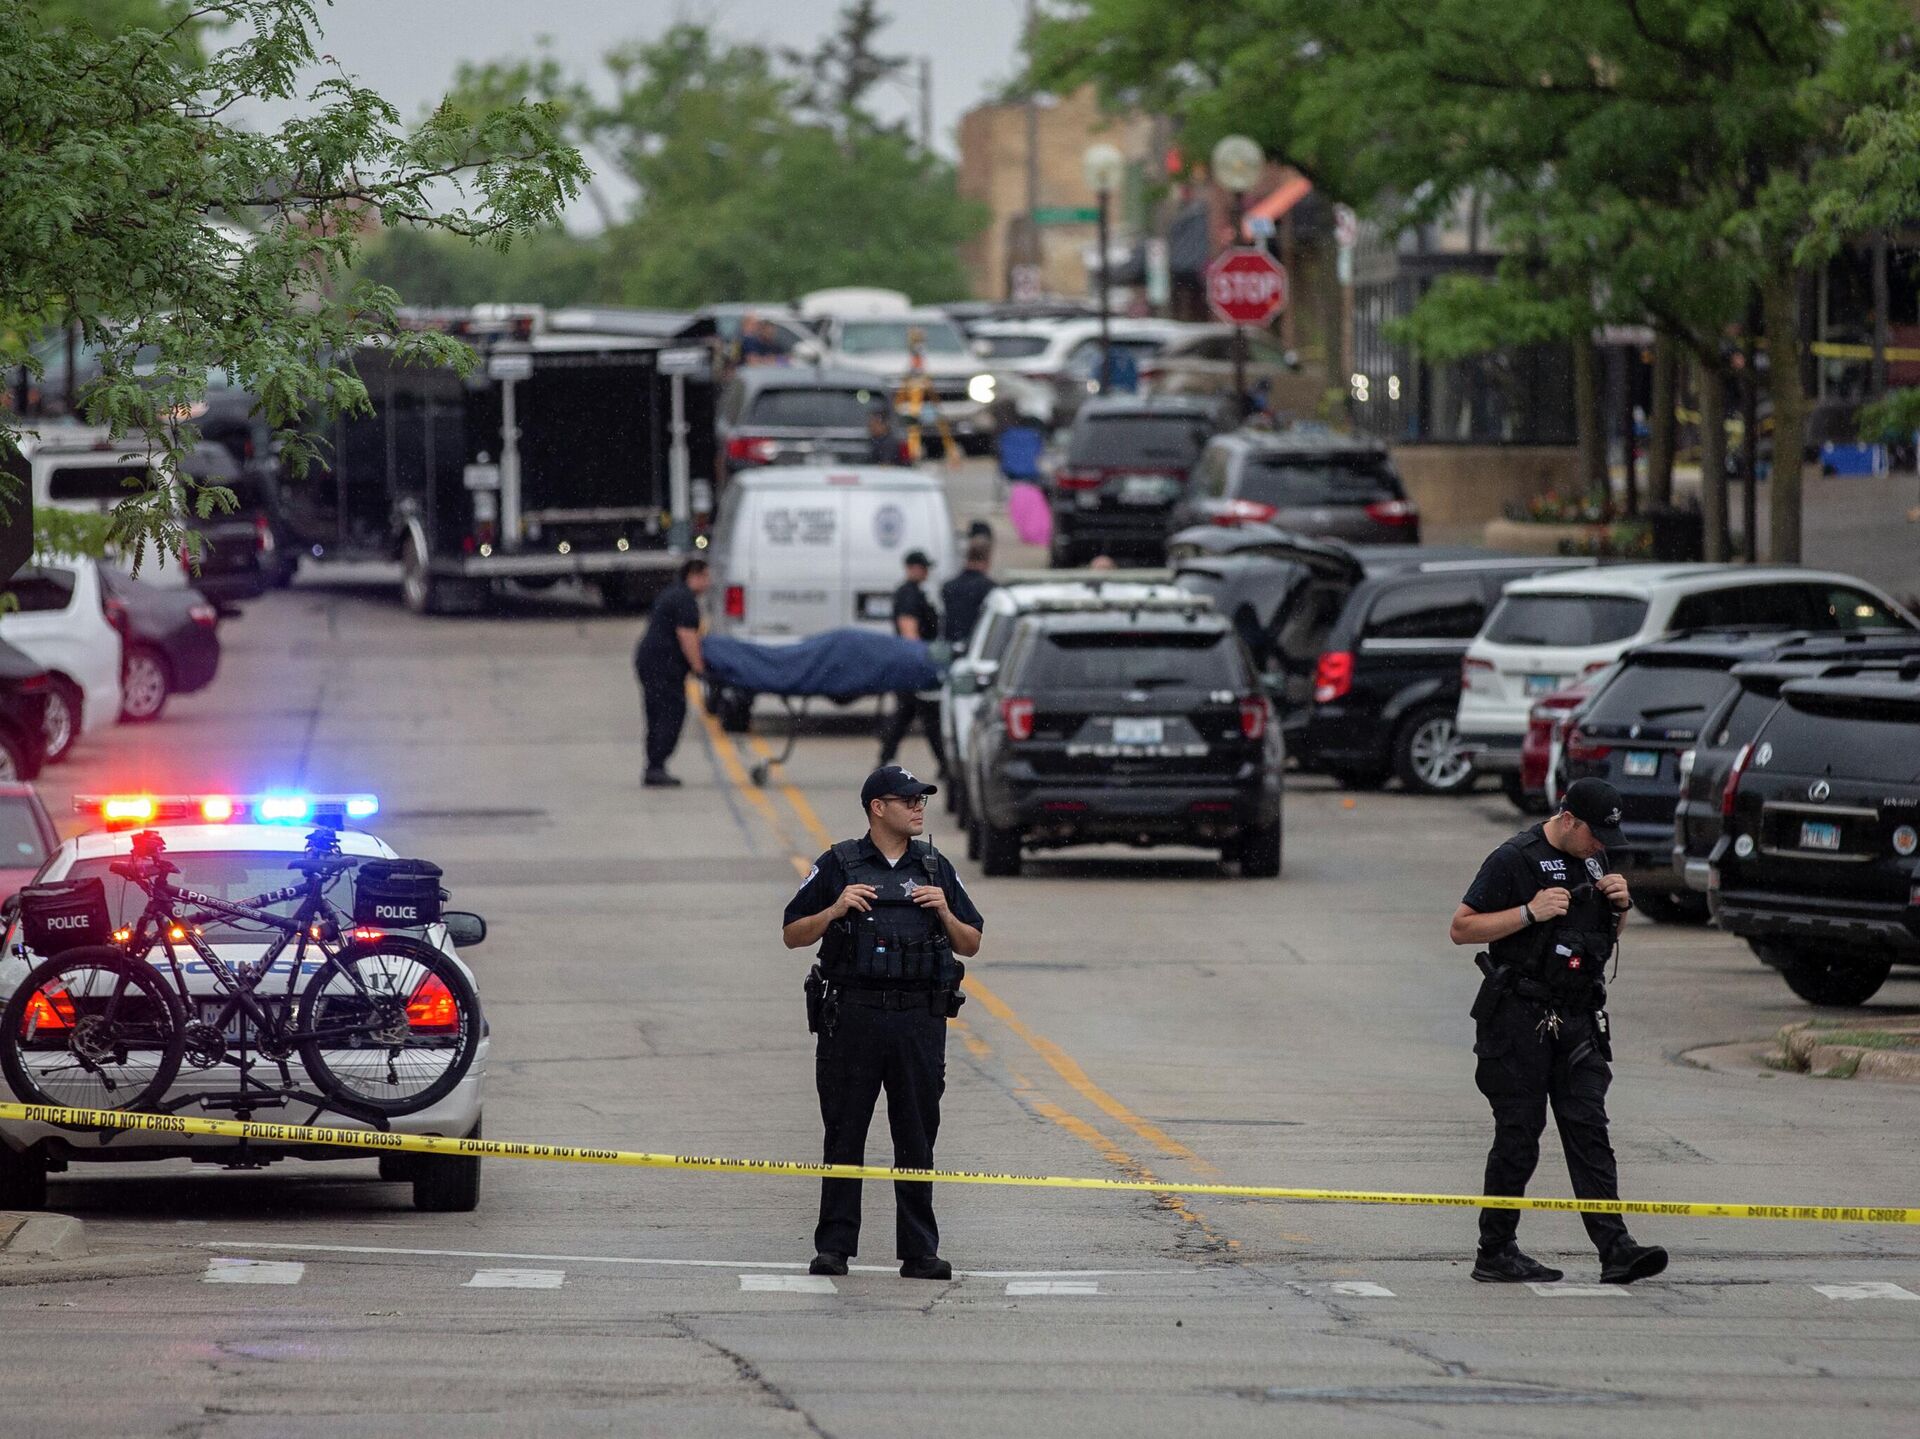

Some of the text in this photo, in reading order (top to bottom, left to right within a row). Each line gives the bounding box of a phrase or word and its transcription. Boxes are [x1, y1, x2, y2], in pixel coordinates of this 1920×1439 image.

[1216, 272, 1281, 304] STOP
[1540, 860, 1567, 872] POLICE
[178, 888, 208, 904] LPD
[376, 905, 418, 919] POLICE
[47, 915, 90, 930] POLICE
[152, 959, 321, 974] POLCE
[368, 973, 398, 989] 17
[25, 1106, 186, 1132] POLICE LINE DO NOT CROSS
[242, 1123, 402, 1147] POLICE LINE DO NOT CROSS
[459, 1140, 501, 1153] POLICE
[504, 1143, 530, 1155] LINE
